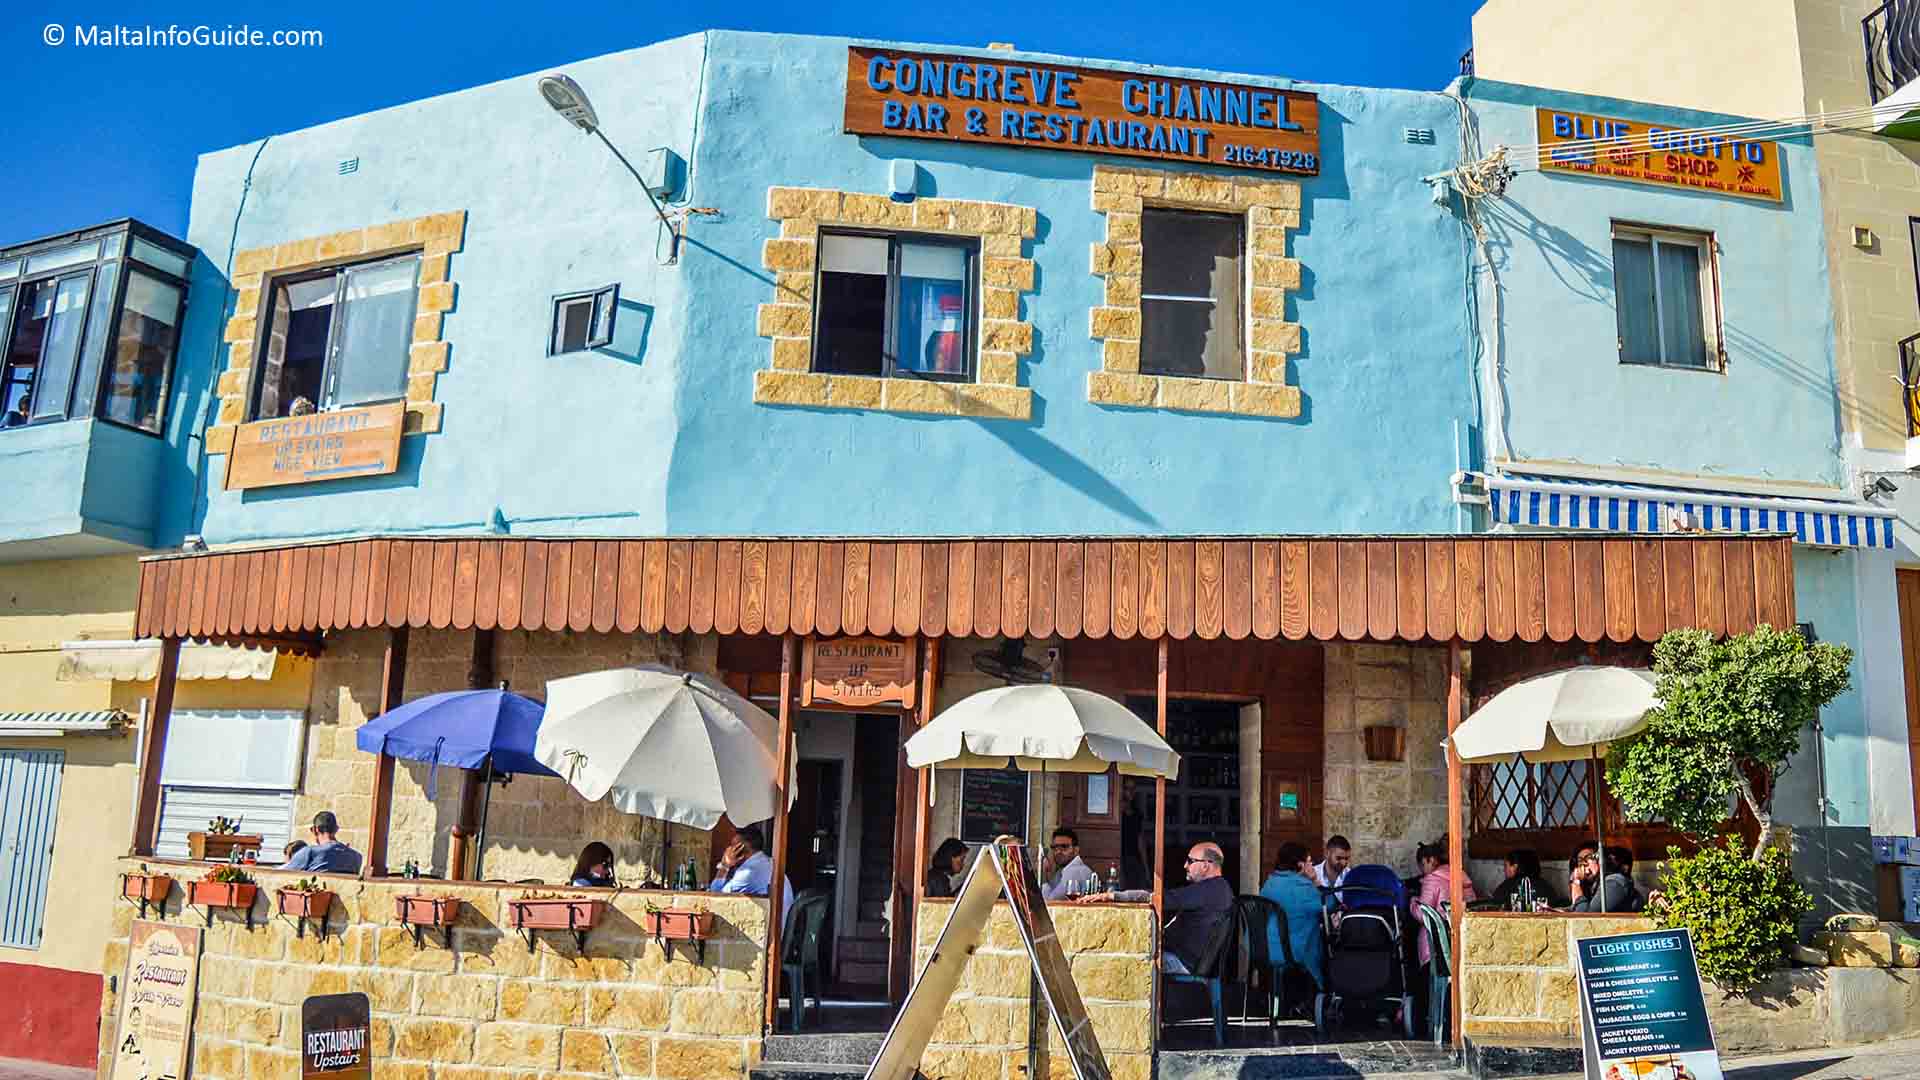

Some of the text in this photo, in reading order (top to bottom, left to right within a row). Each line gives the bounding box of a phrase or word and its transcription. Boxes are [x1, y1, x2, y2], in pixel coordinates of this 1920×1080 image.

[867, 54, 1303, 132] CONGREVE CHANNEL
[882, 100, 1214, 157] BAR & RESTAURANT
[1553, 113, 1765, 164] BLUE GROTTO
[1664, 153, 1720, 178] SHOP
[260, 412, 372, 441] RESTAURANT
[817, 644, 900, 657] RESTAURANT
[847, 663, 869, 677] UP
[832, 683, 882, 697] STAIRS
[1596, 938, 1674, 955] LIGHT DISHES
[134, 959, 188, 987] Restaurant
[1588, 966, 1615, 975] ENGLISH
[308, 1029, 366, 1055] RESTAURANT
[1601, 1028, 1649, 1038] JACKET POTATO
[313, 1050, 361, 1072] Upstairs
[1605, 1047, 1628, 1056] JACKET
[1628, 1045, 1653, 1053] POTATO
